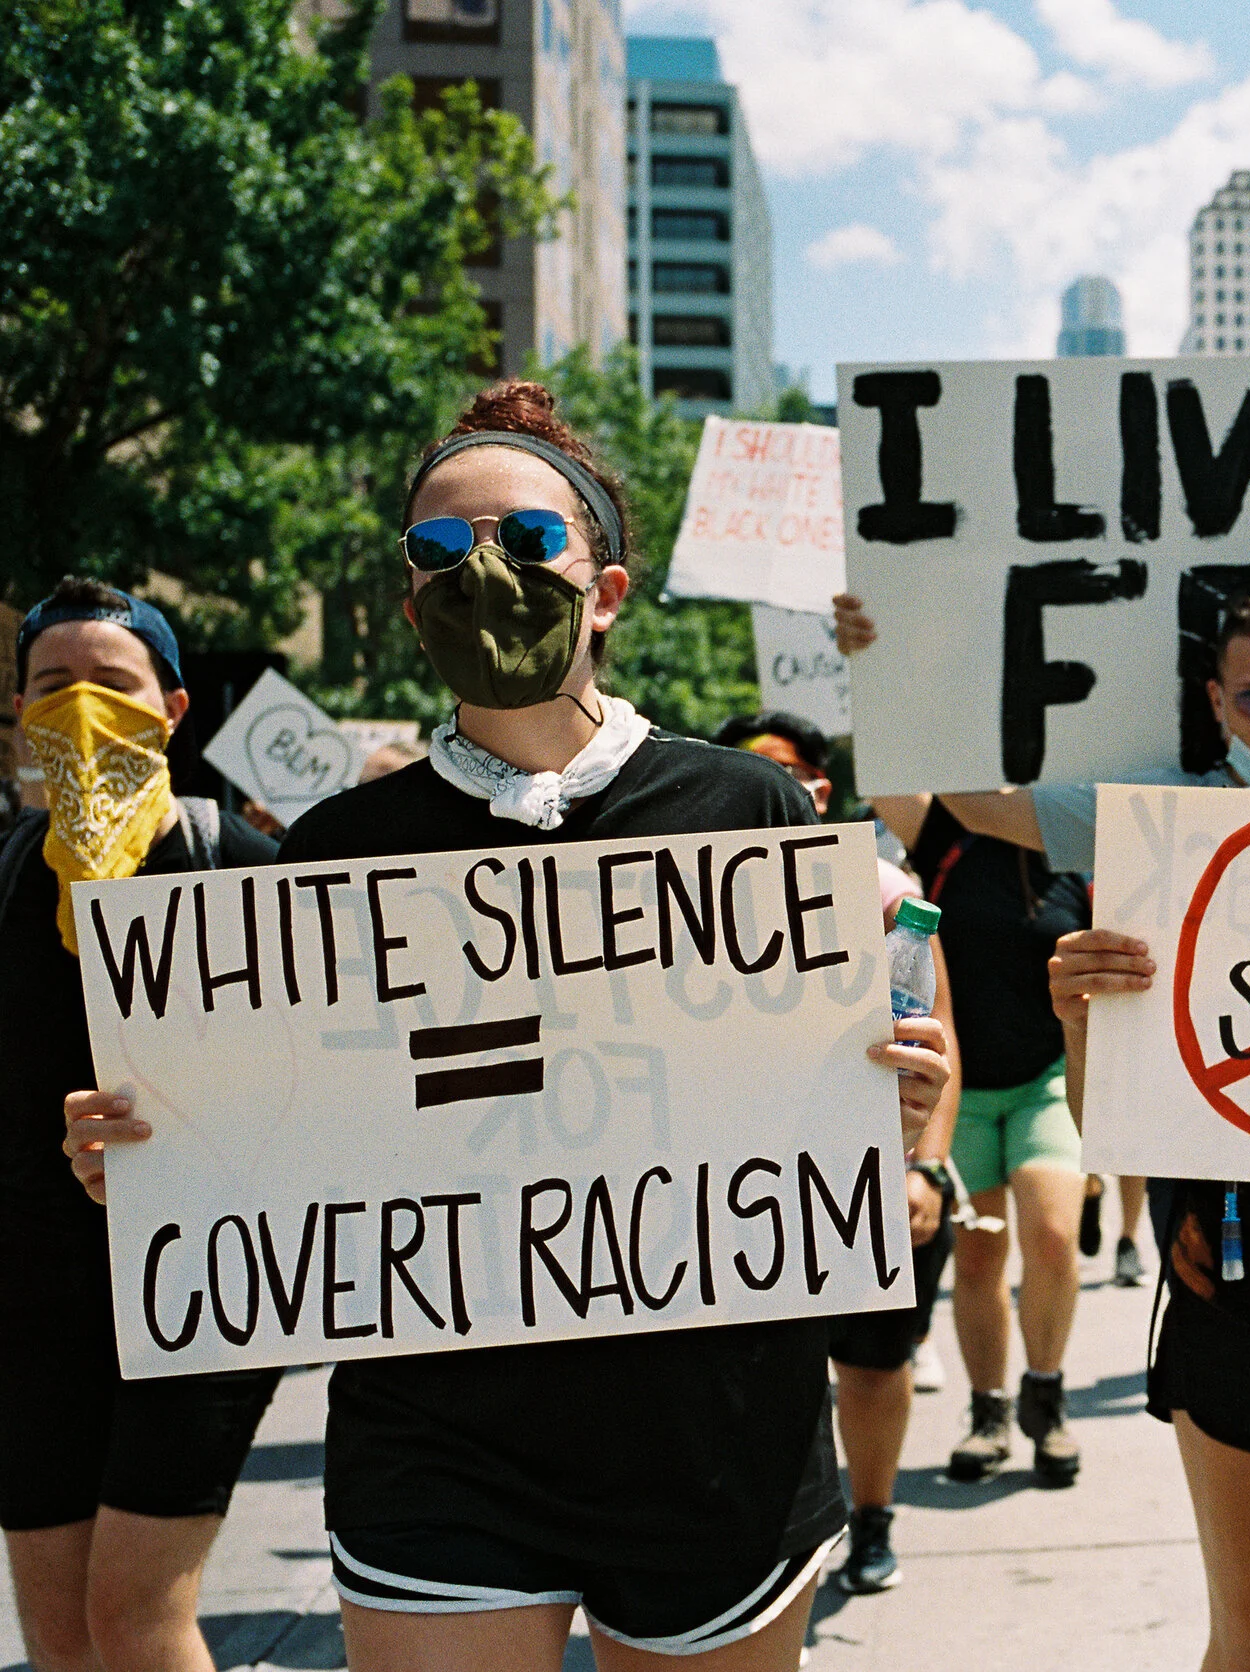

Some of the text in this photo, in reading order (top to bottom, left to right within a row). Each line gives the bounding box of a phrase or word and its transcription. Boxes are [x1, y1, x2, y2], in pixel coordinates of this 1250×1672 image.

[853, 371, 961, 543] I
[266, 728, 331, 791] BLM
[90, 835, 850, 1020] WHITE SILENCE
[143, 1191, 481, 1353] COVERT
[519, 1145, 901, 1327] RACISM
